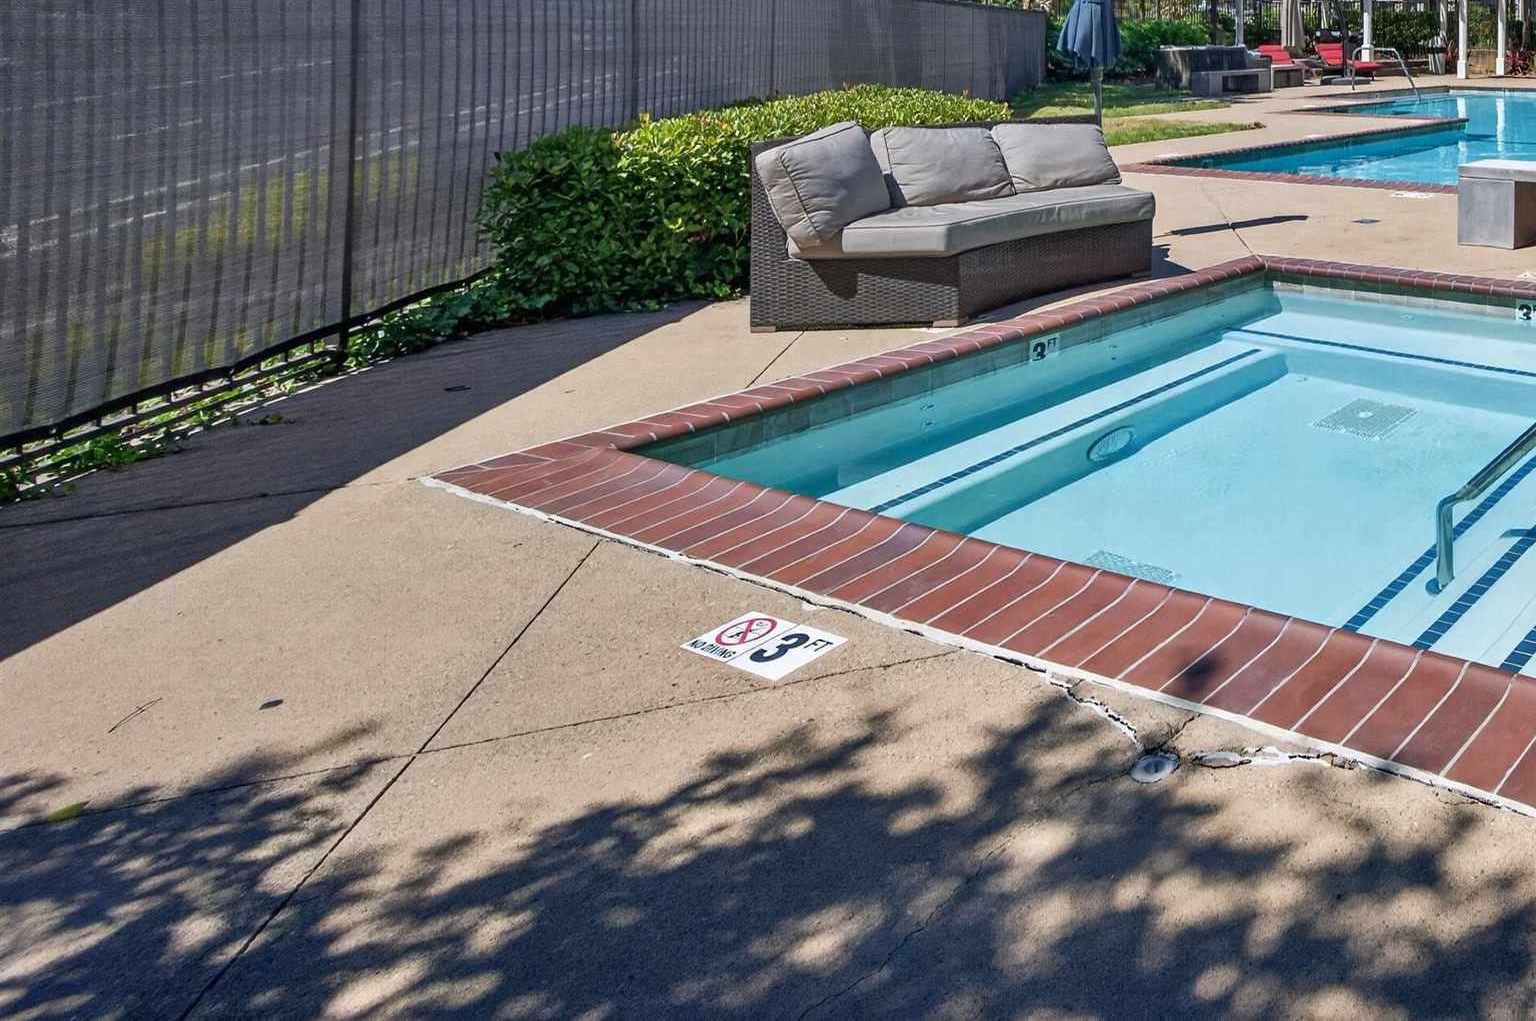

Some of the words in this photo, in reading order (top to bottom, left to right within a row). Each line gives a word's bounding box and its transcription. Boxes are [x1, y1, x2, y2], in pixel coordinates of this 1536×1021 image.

[1518, 303, 1532, 321] 3
[688, 639, 707, 649] NO
[700, 643, 737, 658] DIVING
[749, 633, 810, 663] 3
[803, 638, 834, 652] FT
